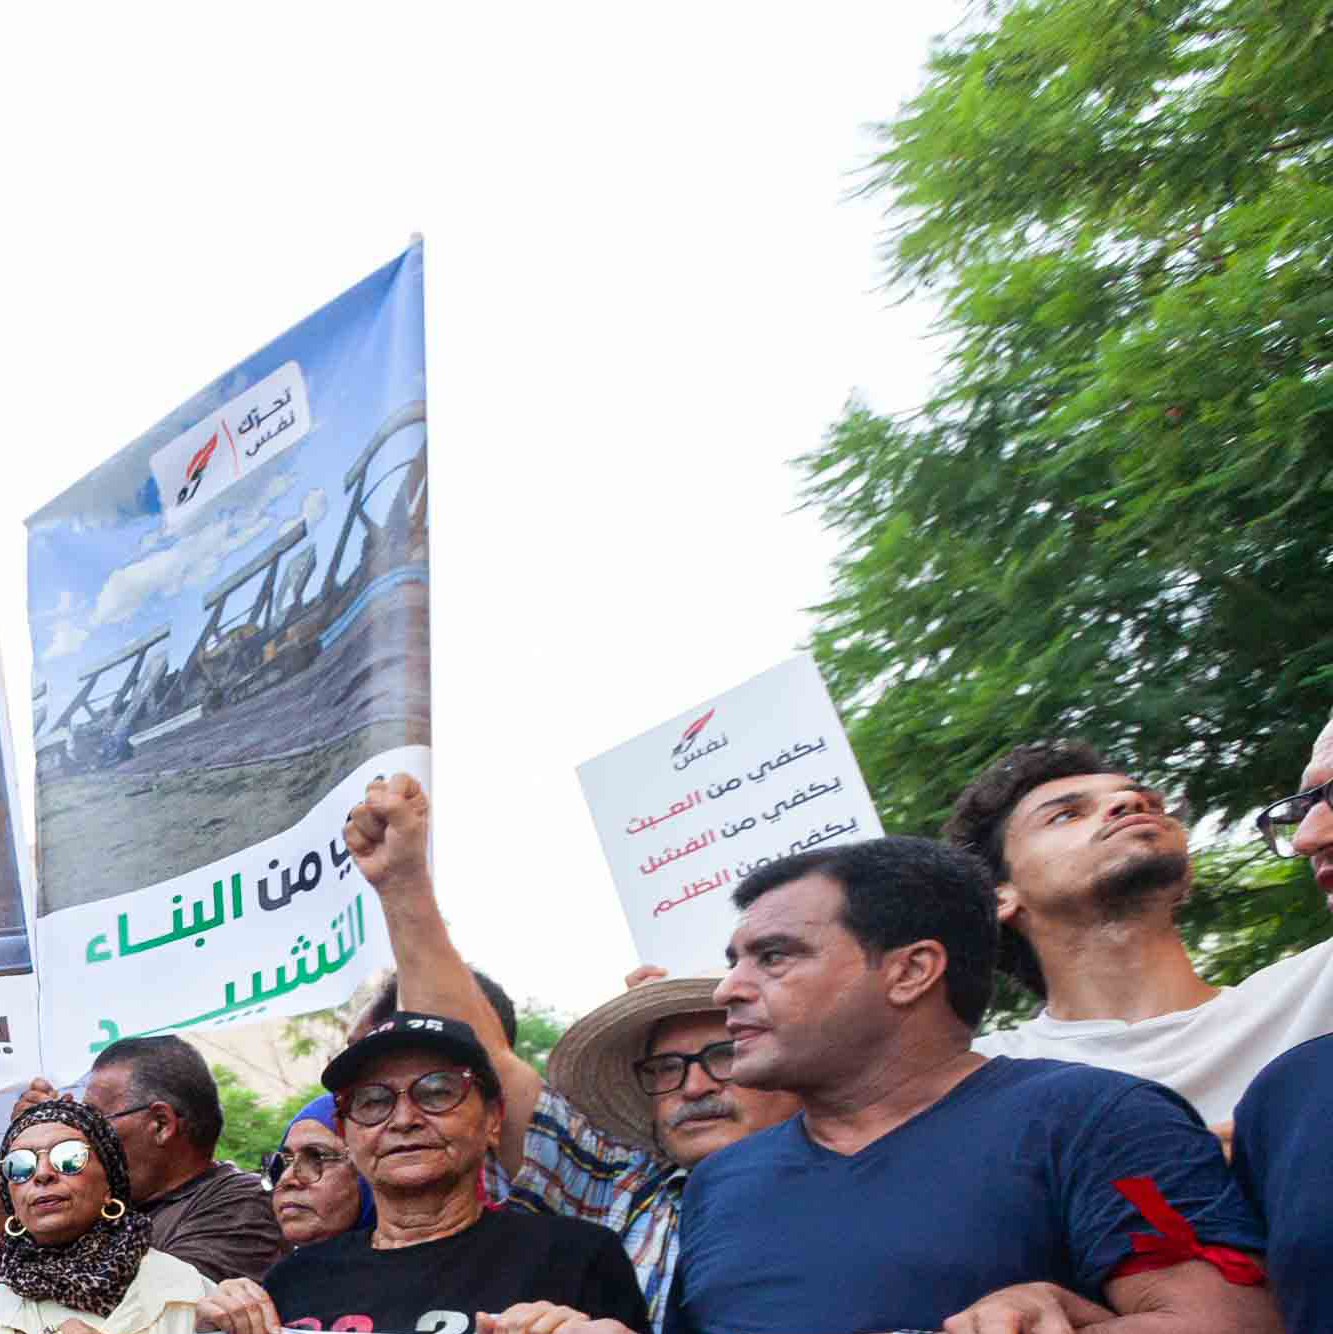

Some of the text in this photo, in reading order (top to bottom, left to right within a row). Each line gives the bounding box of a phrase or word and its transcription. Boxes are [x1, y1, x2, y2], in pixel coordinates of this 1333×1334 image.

[245, 410, 296, 457] نفس
[625, 736, 827, 834] يكفي من العبث
[673, 732, 730, 771] نفس
[639, 775, 843, 875] يكفي من الفشل
[85, 850, 323, 964] من البناء
[652, 868, 731, 918] الظلم
